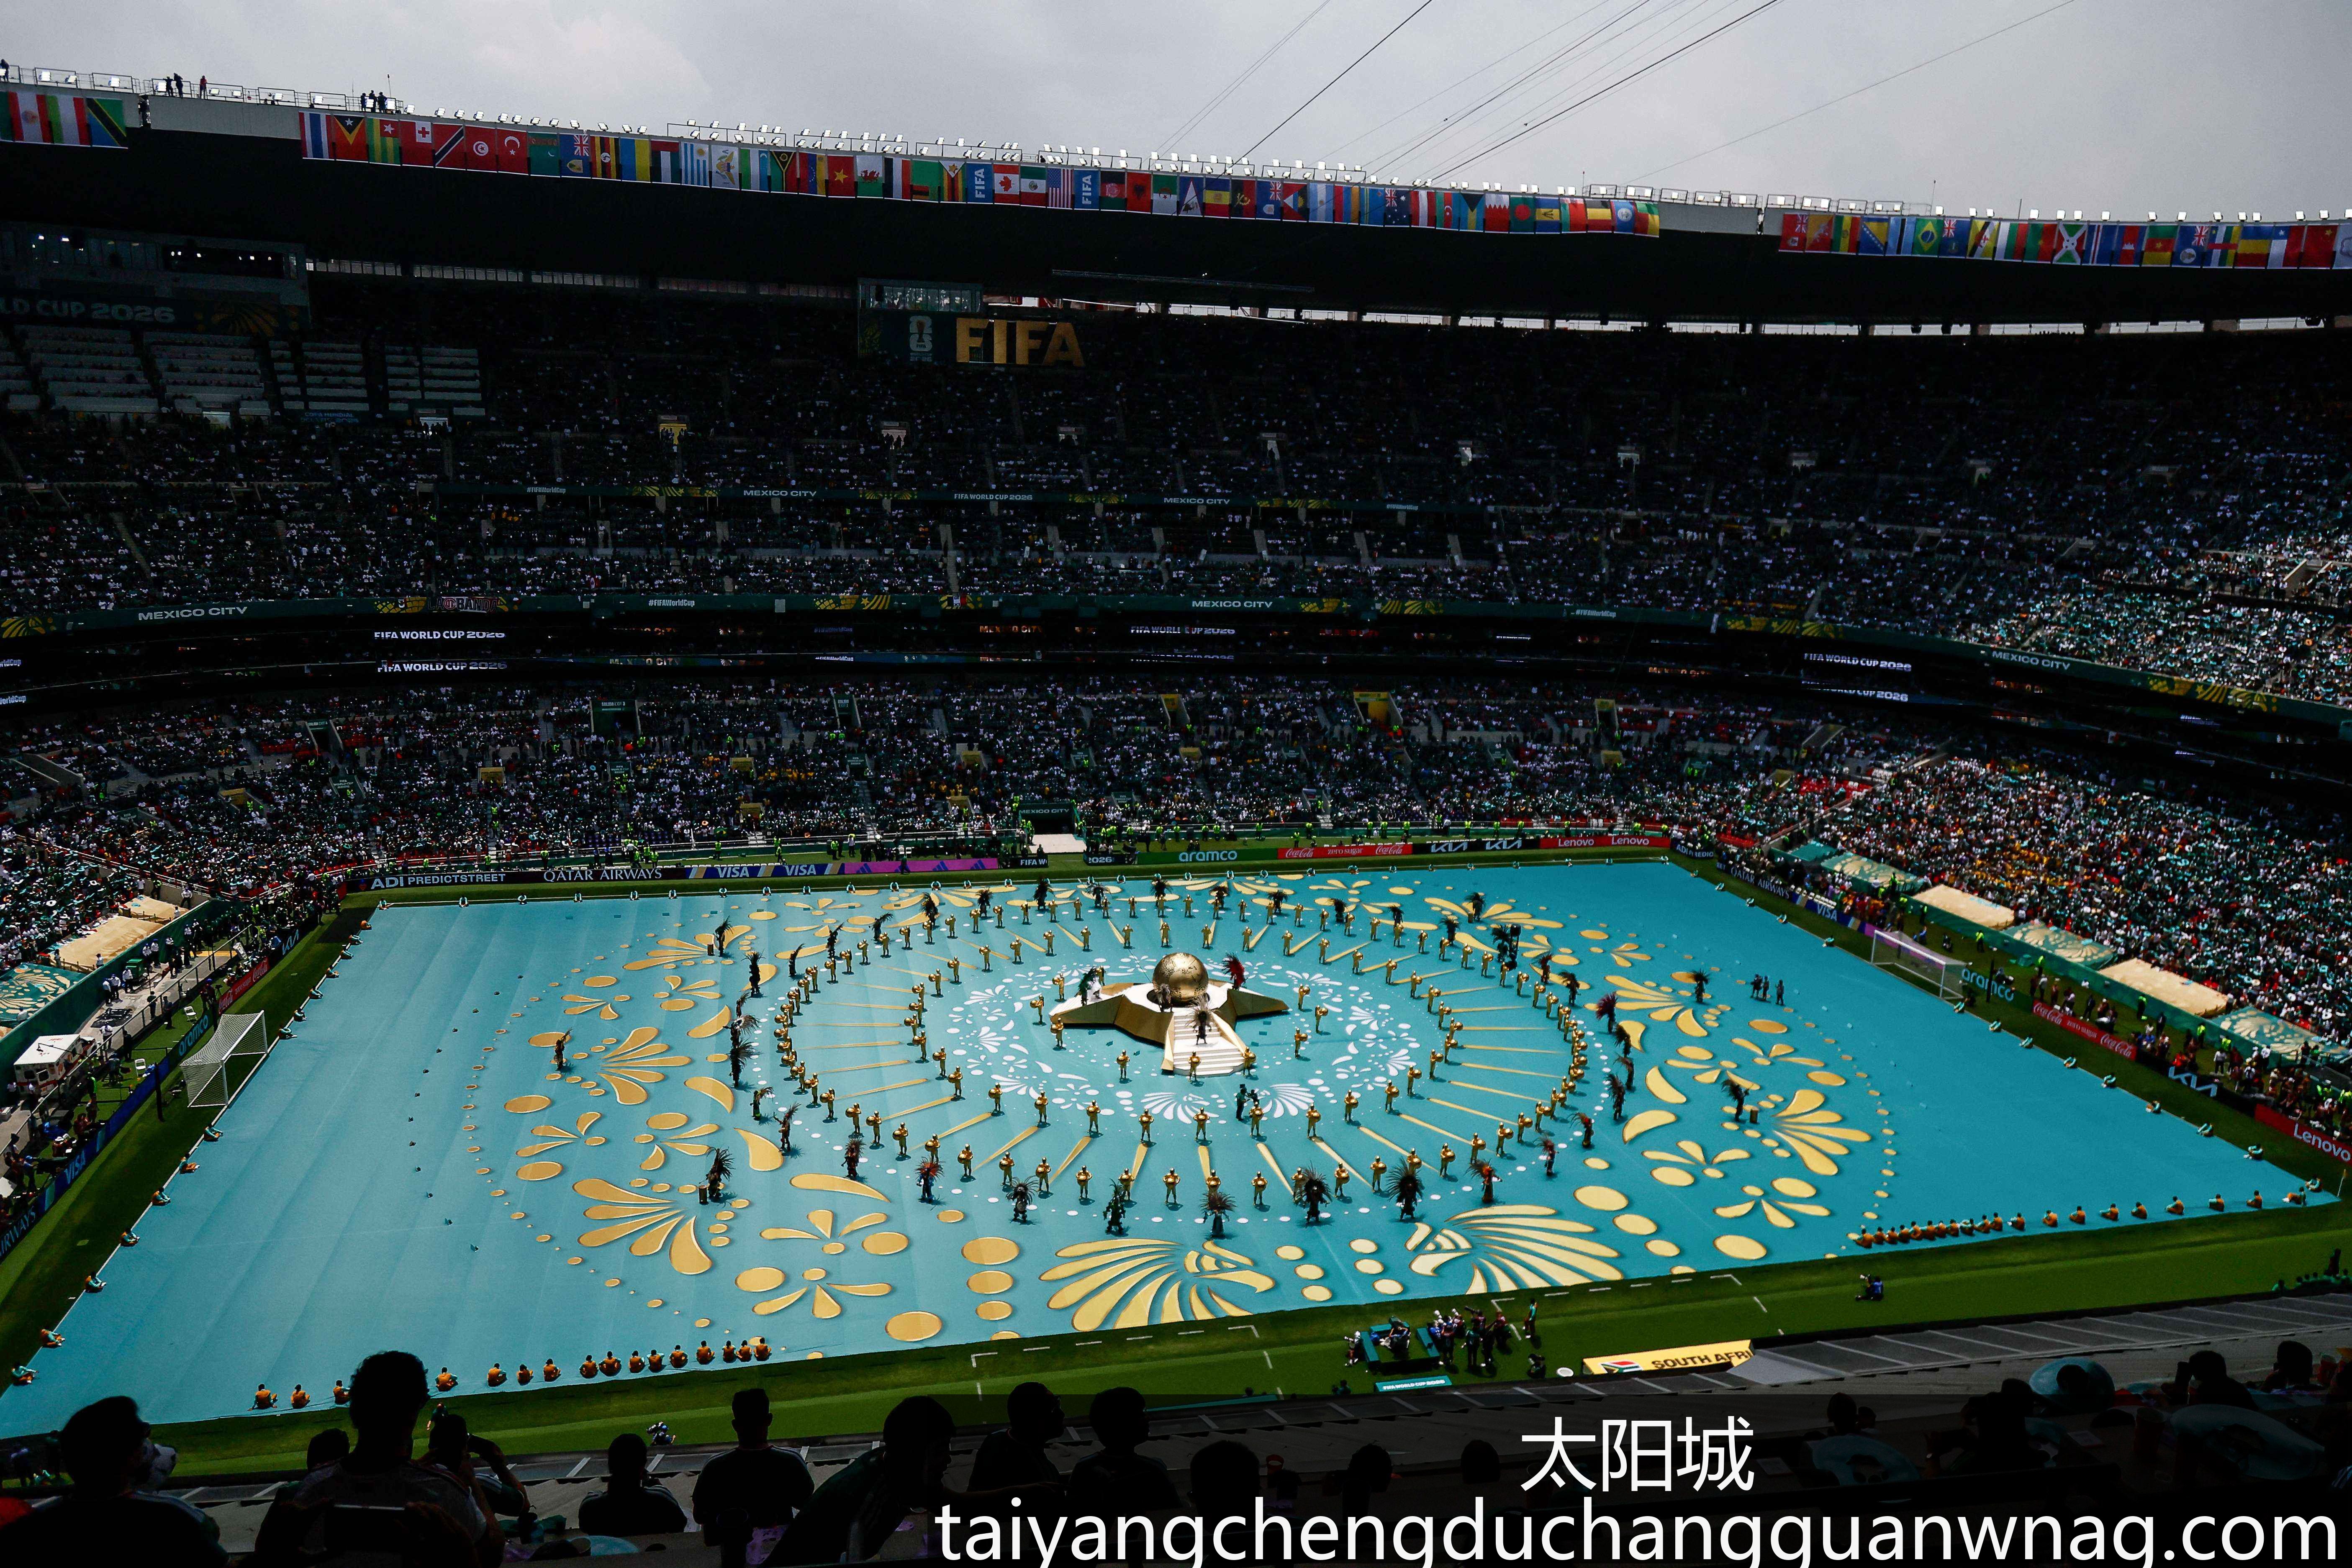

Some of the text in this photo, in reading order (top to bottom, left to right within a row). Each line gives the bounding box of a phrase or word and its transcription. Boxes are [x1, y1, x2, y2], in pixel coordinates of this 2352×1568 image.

[975, 168, 985, 198] FIFA
[1081, 175, 1091, 205] FIFA
[36, 299, 86, 318] CUP
[91, 302, 176, 323] 2026
[956, 318, 1086, 368] FIFA
[138, 606, 248, 621] MEXICO CITY
[374, 631, 398, 640] FIFA
[443, 631, 465, 639] CUP
[403, 663, 444, 672] WORLD
[445, 662, 467, 671] CUP
[468, 662, 508, 670] 2026
[1804, 653, 1824, 661] FIFA
[1825, 654, 1859, 665] WORLD
[1860, 658, 1879, 667] CUP
[1992, 651, 2070, 670] MEXICO CITY
[1876, 691, 1909, 703] 2026
[1431, 842, 1469, 852] KIA
[1486, 839, 1523, 850] KIA
[1559, 838, 1595, 847] Lenovo
[1611, 836, 1650, 846] Lenovo
[1179, 851, 1238, 862] aramco
[1285, 848, 1314, 858] Coca-Cola
[1375, 845, 1404, 856] Coca-Cola
[543, 868, 662, 883] QATAR AIRWAYS
[717, 867, 750, 878] VISA
[784, 865, 817, 877] VISA
[371, 873, 506, 890] ADI PREDICTSTREET
[1731, 866, 1755, 884] QATAR
[1758, 878, 1790, 900] AIRWAYS
[1817, 903, 1838, 922] VISA
[282, 929, 299, 956] KIA
[1962, 967, 2015, 1002] aramco
[179, 1014, 208, 1057] aramco
[2033, 1001, 2063, 1025] Coca-Cola
[2100, 1033, 2135, 1057] Coca-Cola
[2168, 1065, 2218, 1098] KIA
[2293, 1123, 2351, 1162] Lenovo
[64, 1149, 86, 1185] VISA
[0, 1205, 37, 1257] IRWAYS
[1651, 1355, 1710, 1369] SOUTH
